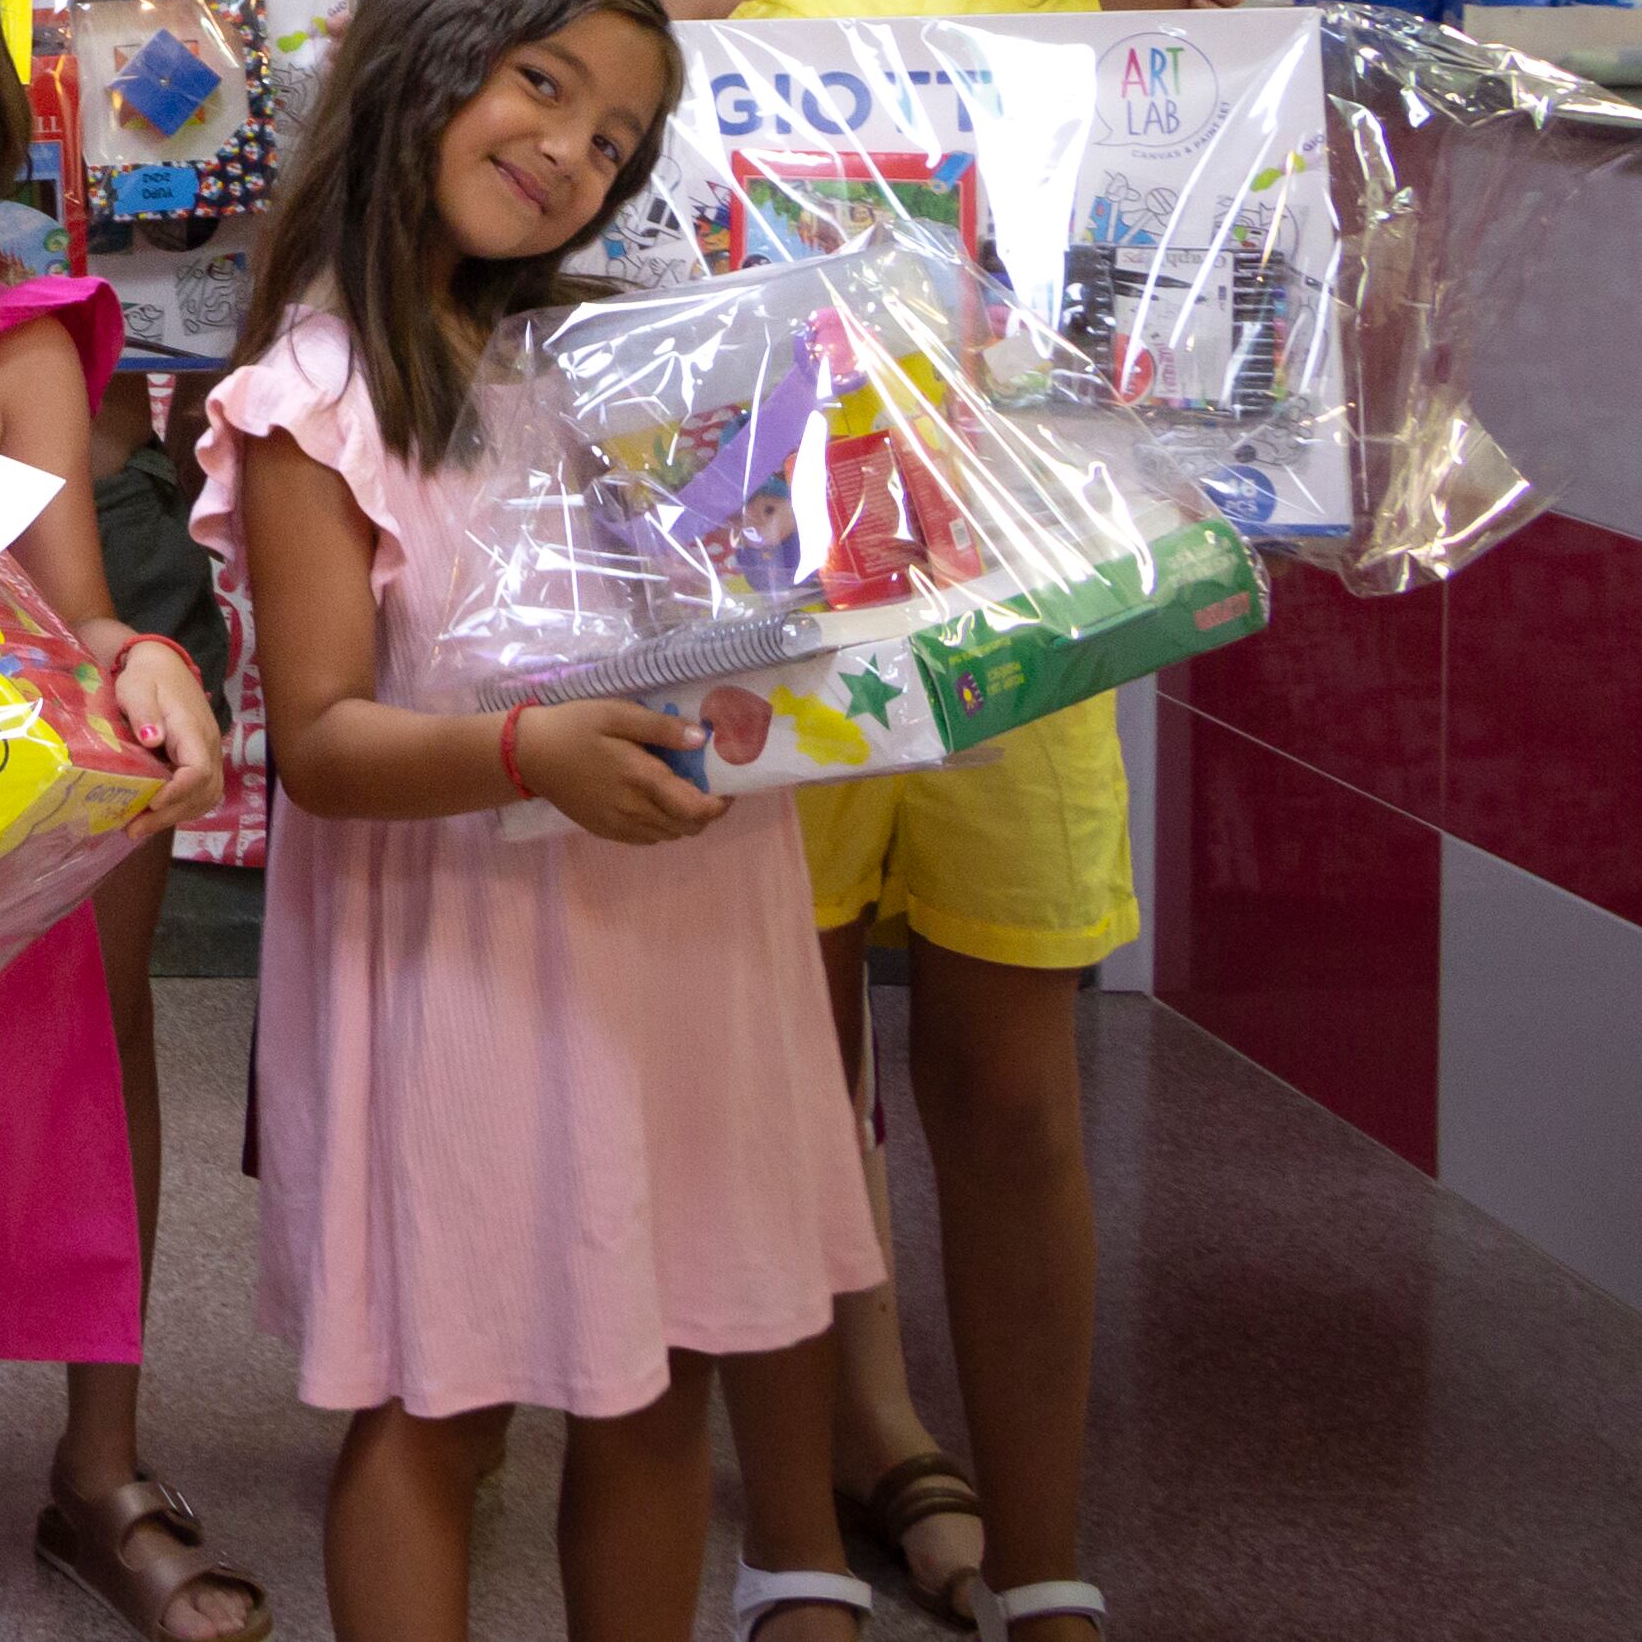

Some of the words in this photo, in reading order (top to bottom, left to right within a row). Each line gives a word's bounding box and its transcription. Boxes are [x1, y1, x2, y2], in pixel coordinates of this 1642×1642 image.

[1121, 47, 1185, 98] ART
[1127, 99, 1181, 136] LAB
[1131, 149, 1181, 159] CANVAS
